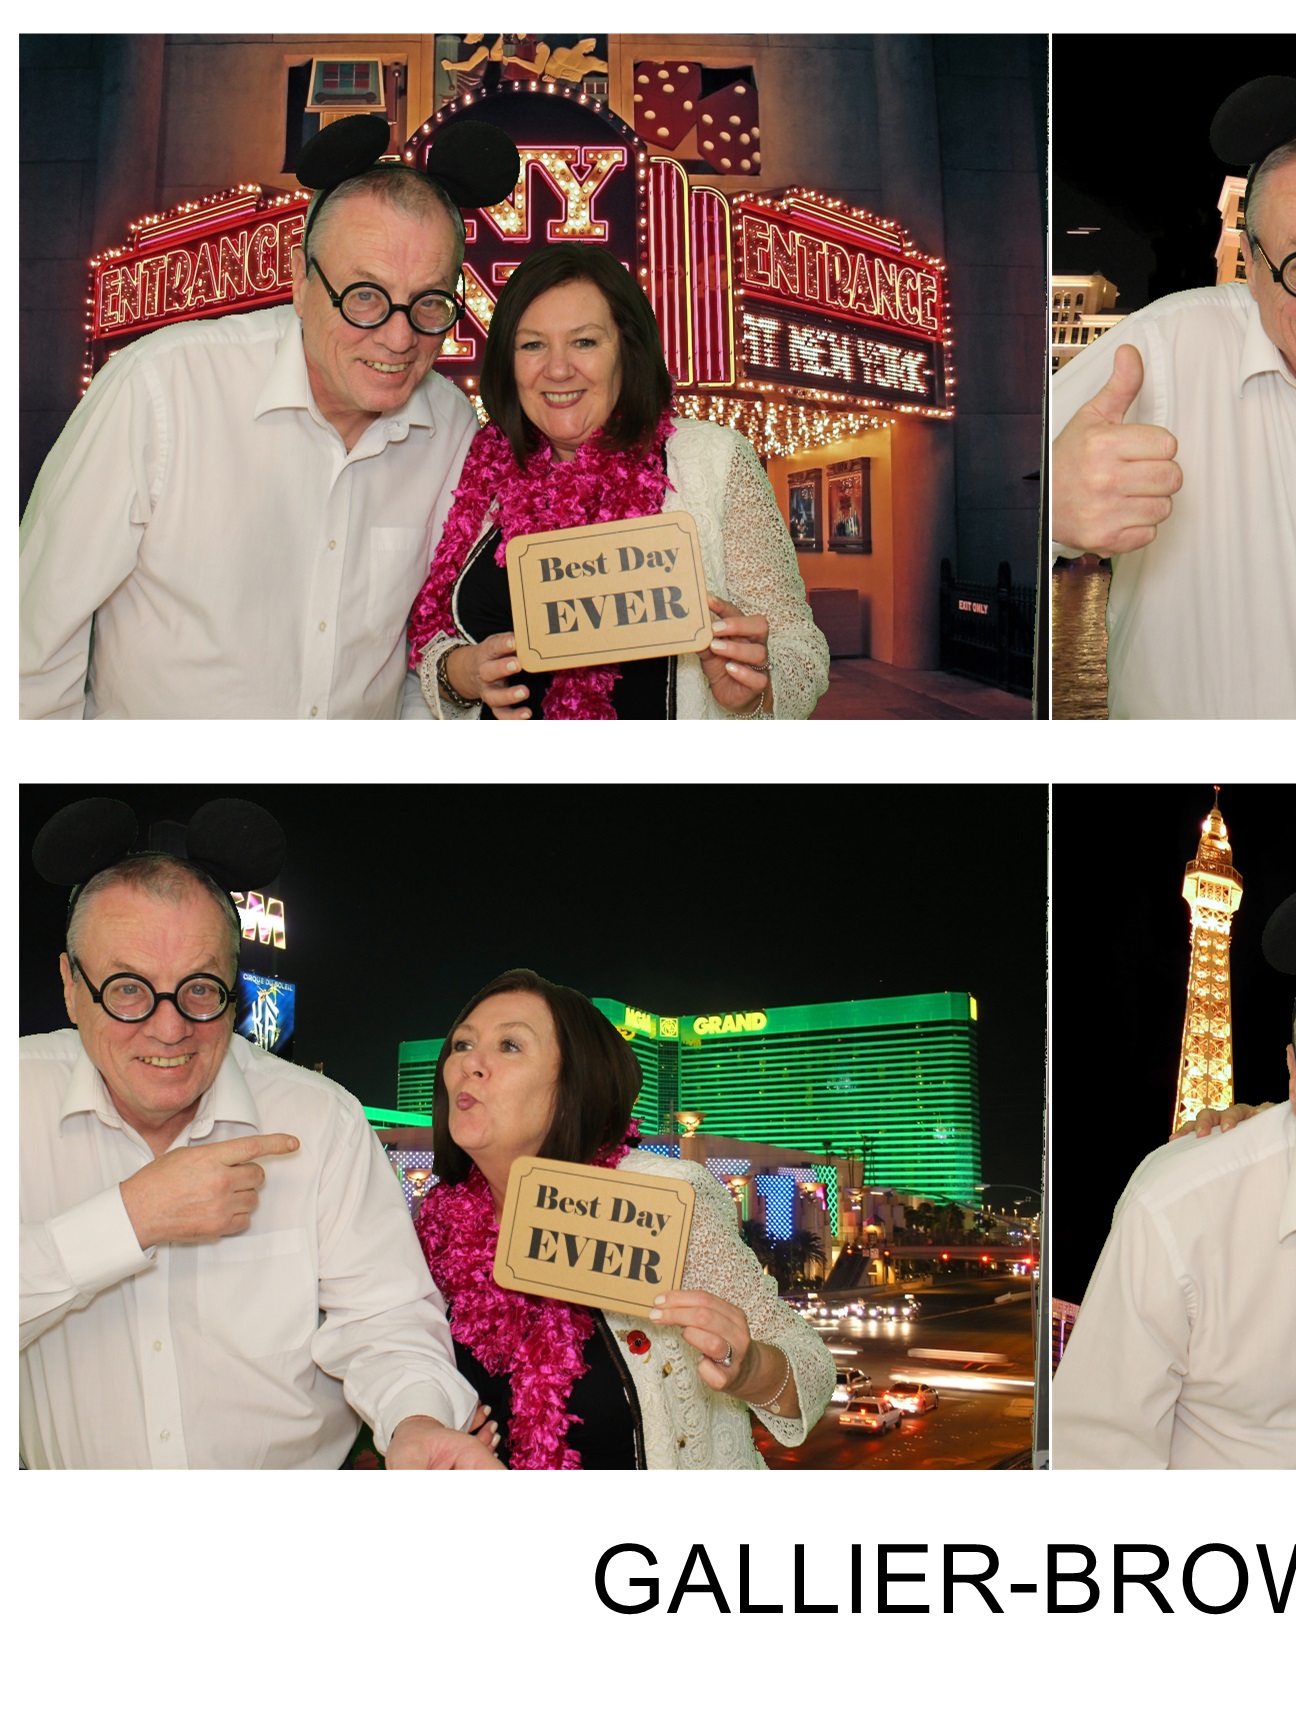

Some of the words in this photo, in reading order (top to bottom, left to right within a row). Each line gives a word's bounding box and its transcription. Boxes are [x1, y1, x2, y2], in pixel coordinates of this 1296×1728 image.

[100, 215, 305, 327] ENTRANCE
[743, 215, 938, 330] ENTRANCE
[537, 551, 610, 583] Best
[616, 546, 680, 573] Day
[542, 585, 689, 635] EVER
[958, 600, 971, 611] EXIT
[972, 602, 988, 615] ONLY
[243, 973, 264, 985] CIRQUE
[274, 981, 293, 992] SOLEIL
[693, 1011, 767, 1035] GRAND
[534, 1183, 601, 1219] Best
[608, 1197, 672, 1237] Day
[524, 1226, 662, 1284] EVER
